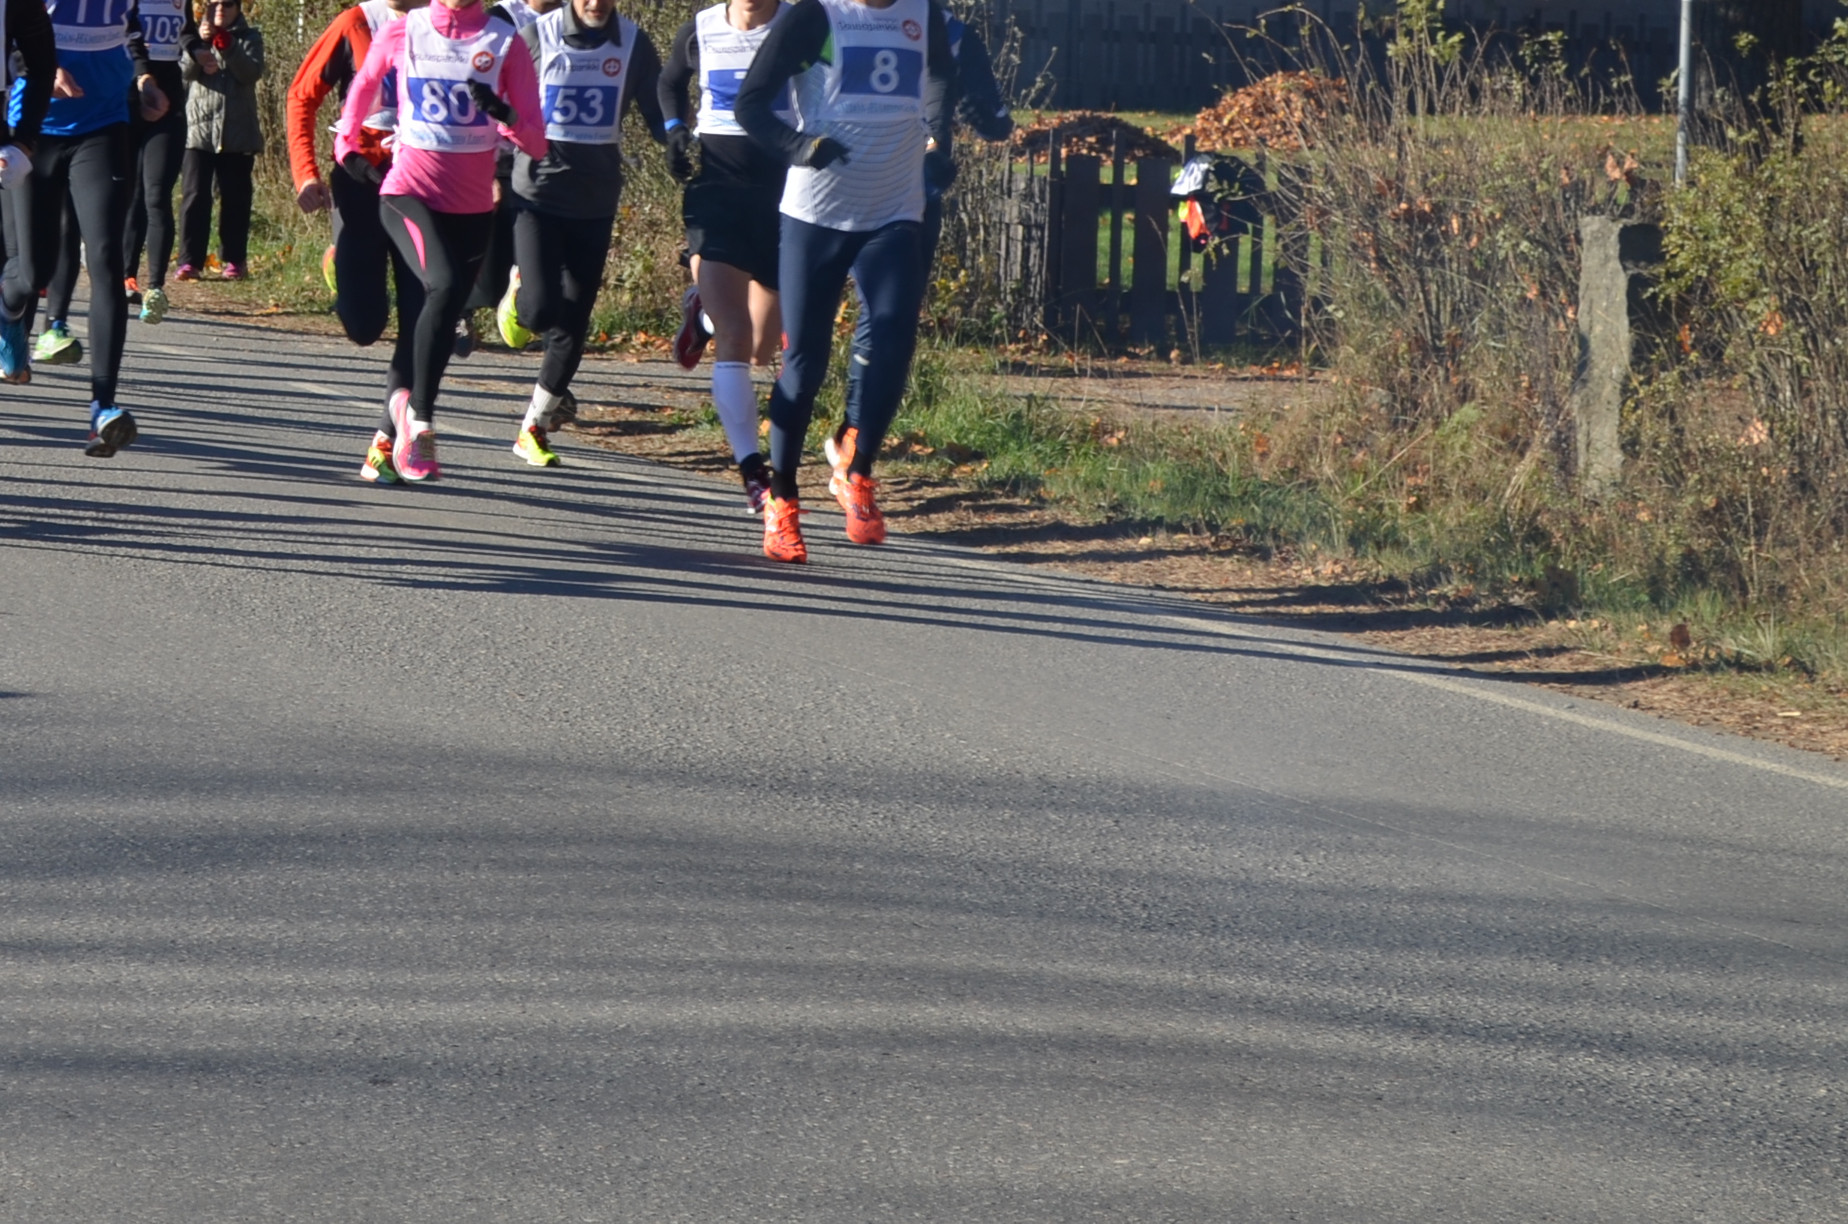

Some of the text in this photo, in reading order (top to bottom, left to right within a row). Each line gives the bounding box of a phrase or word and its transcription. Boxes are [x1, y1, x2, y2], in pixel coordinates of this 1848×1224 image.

[144, 17, 182, 44] 103
[870, 49, 900, 94] 8
[420, 80, 476, 124] 80
[552, 88, 604, 125] 53
